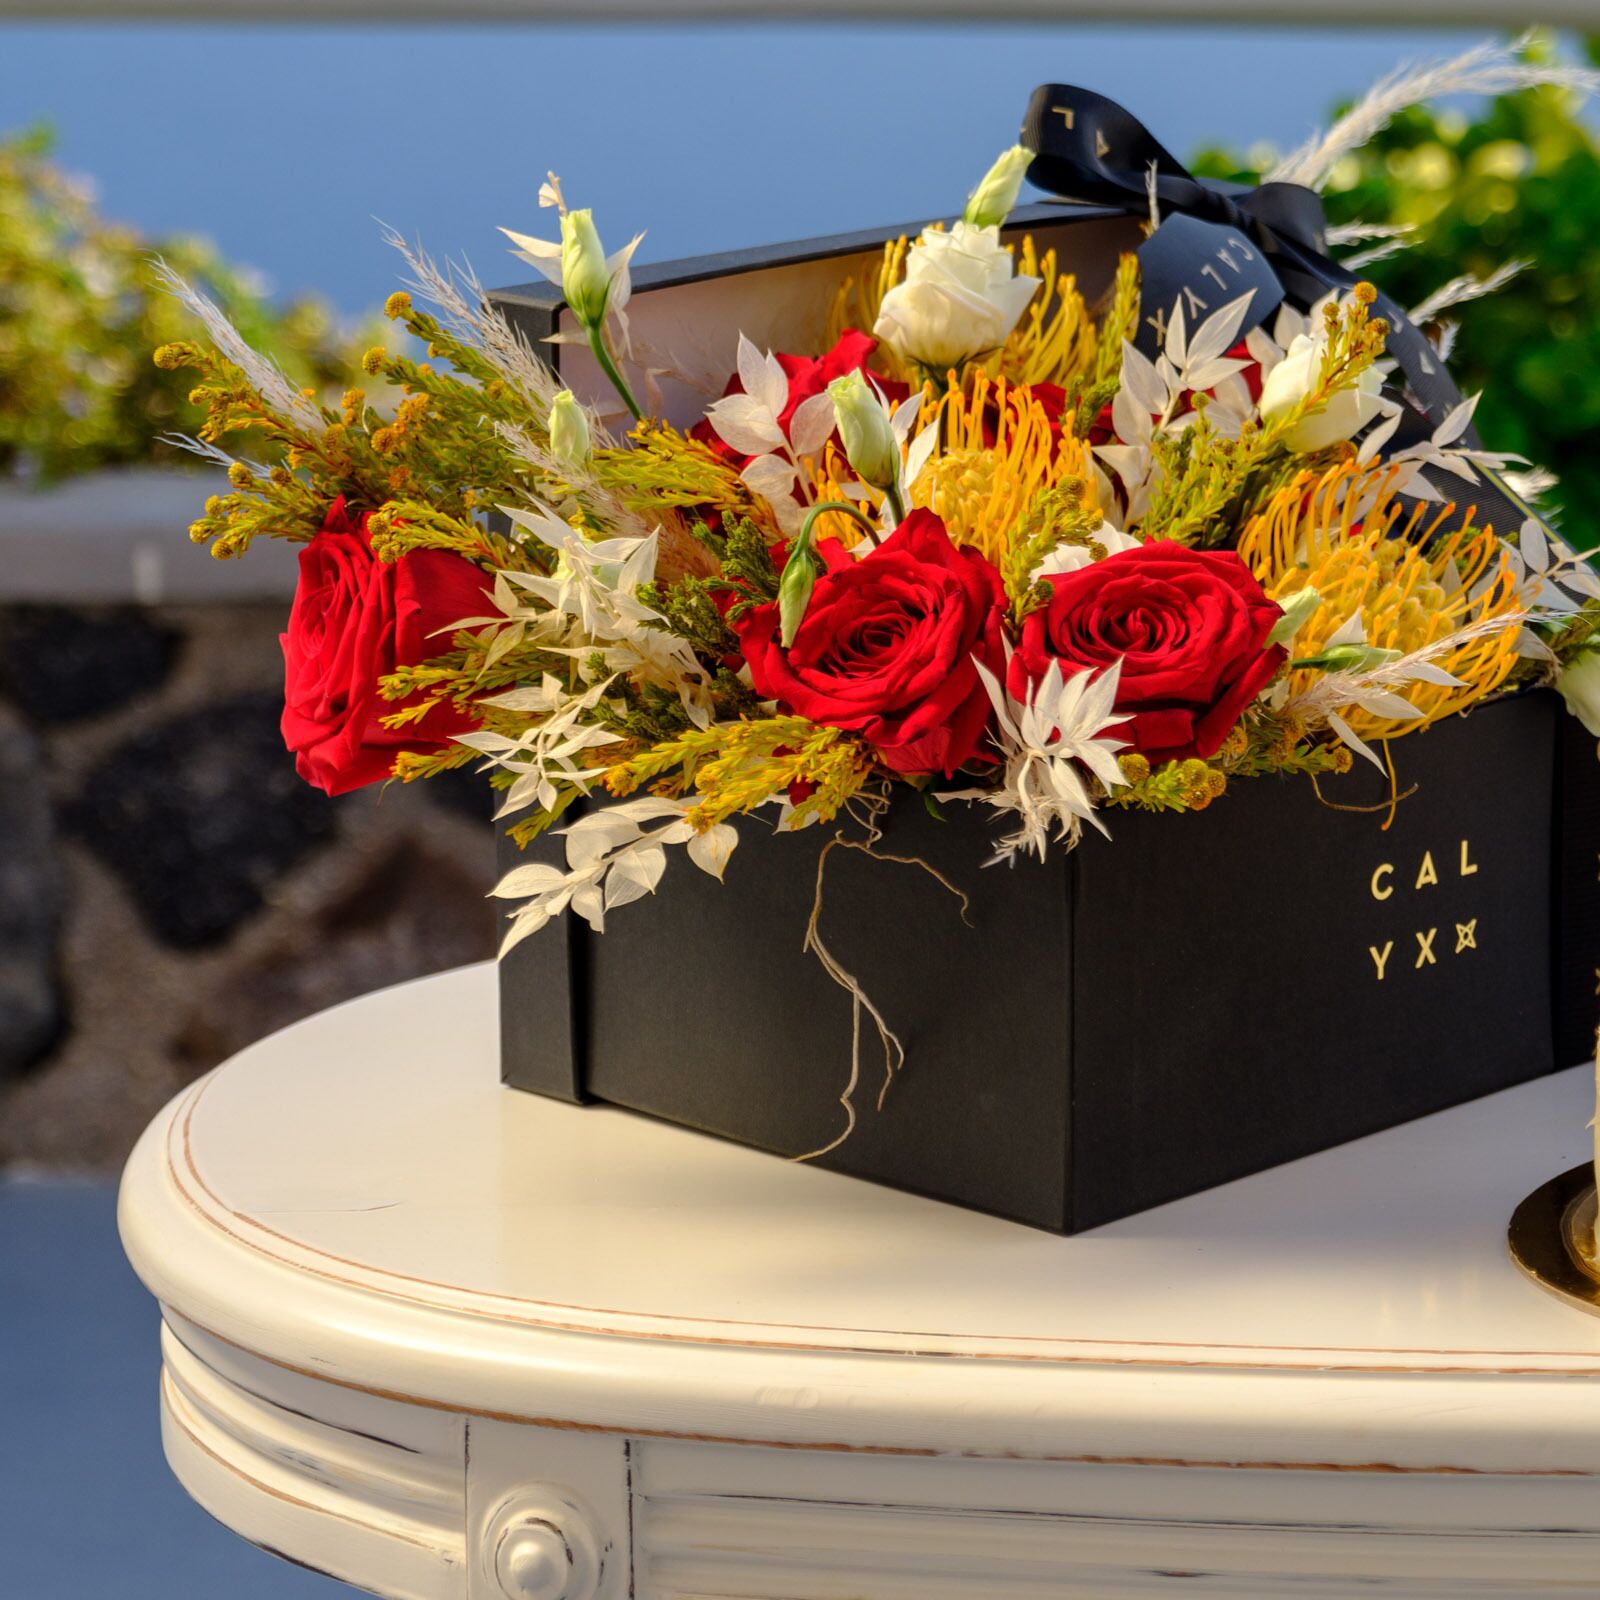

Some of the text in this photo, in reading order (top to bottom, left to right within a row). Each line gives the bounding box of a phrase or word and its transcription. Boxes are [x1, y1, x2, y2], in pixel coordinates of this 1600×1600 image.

[1146, 238, 1254, 347] CALYX
[1370, 839, 1478, 901] CAL
[1369, 927, 1438, 981] YX
